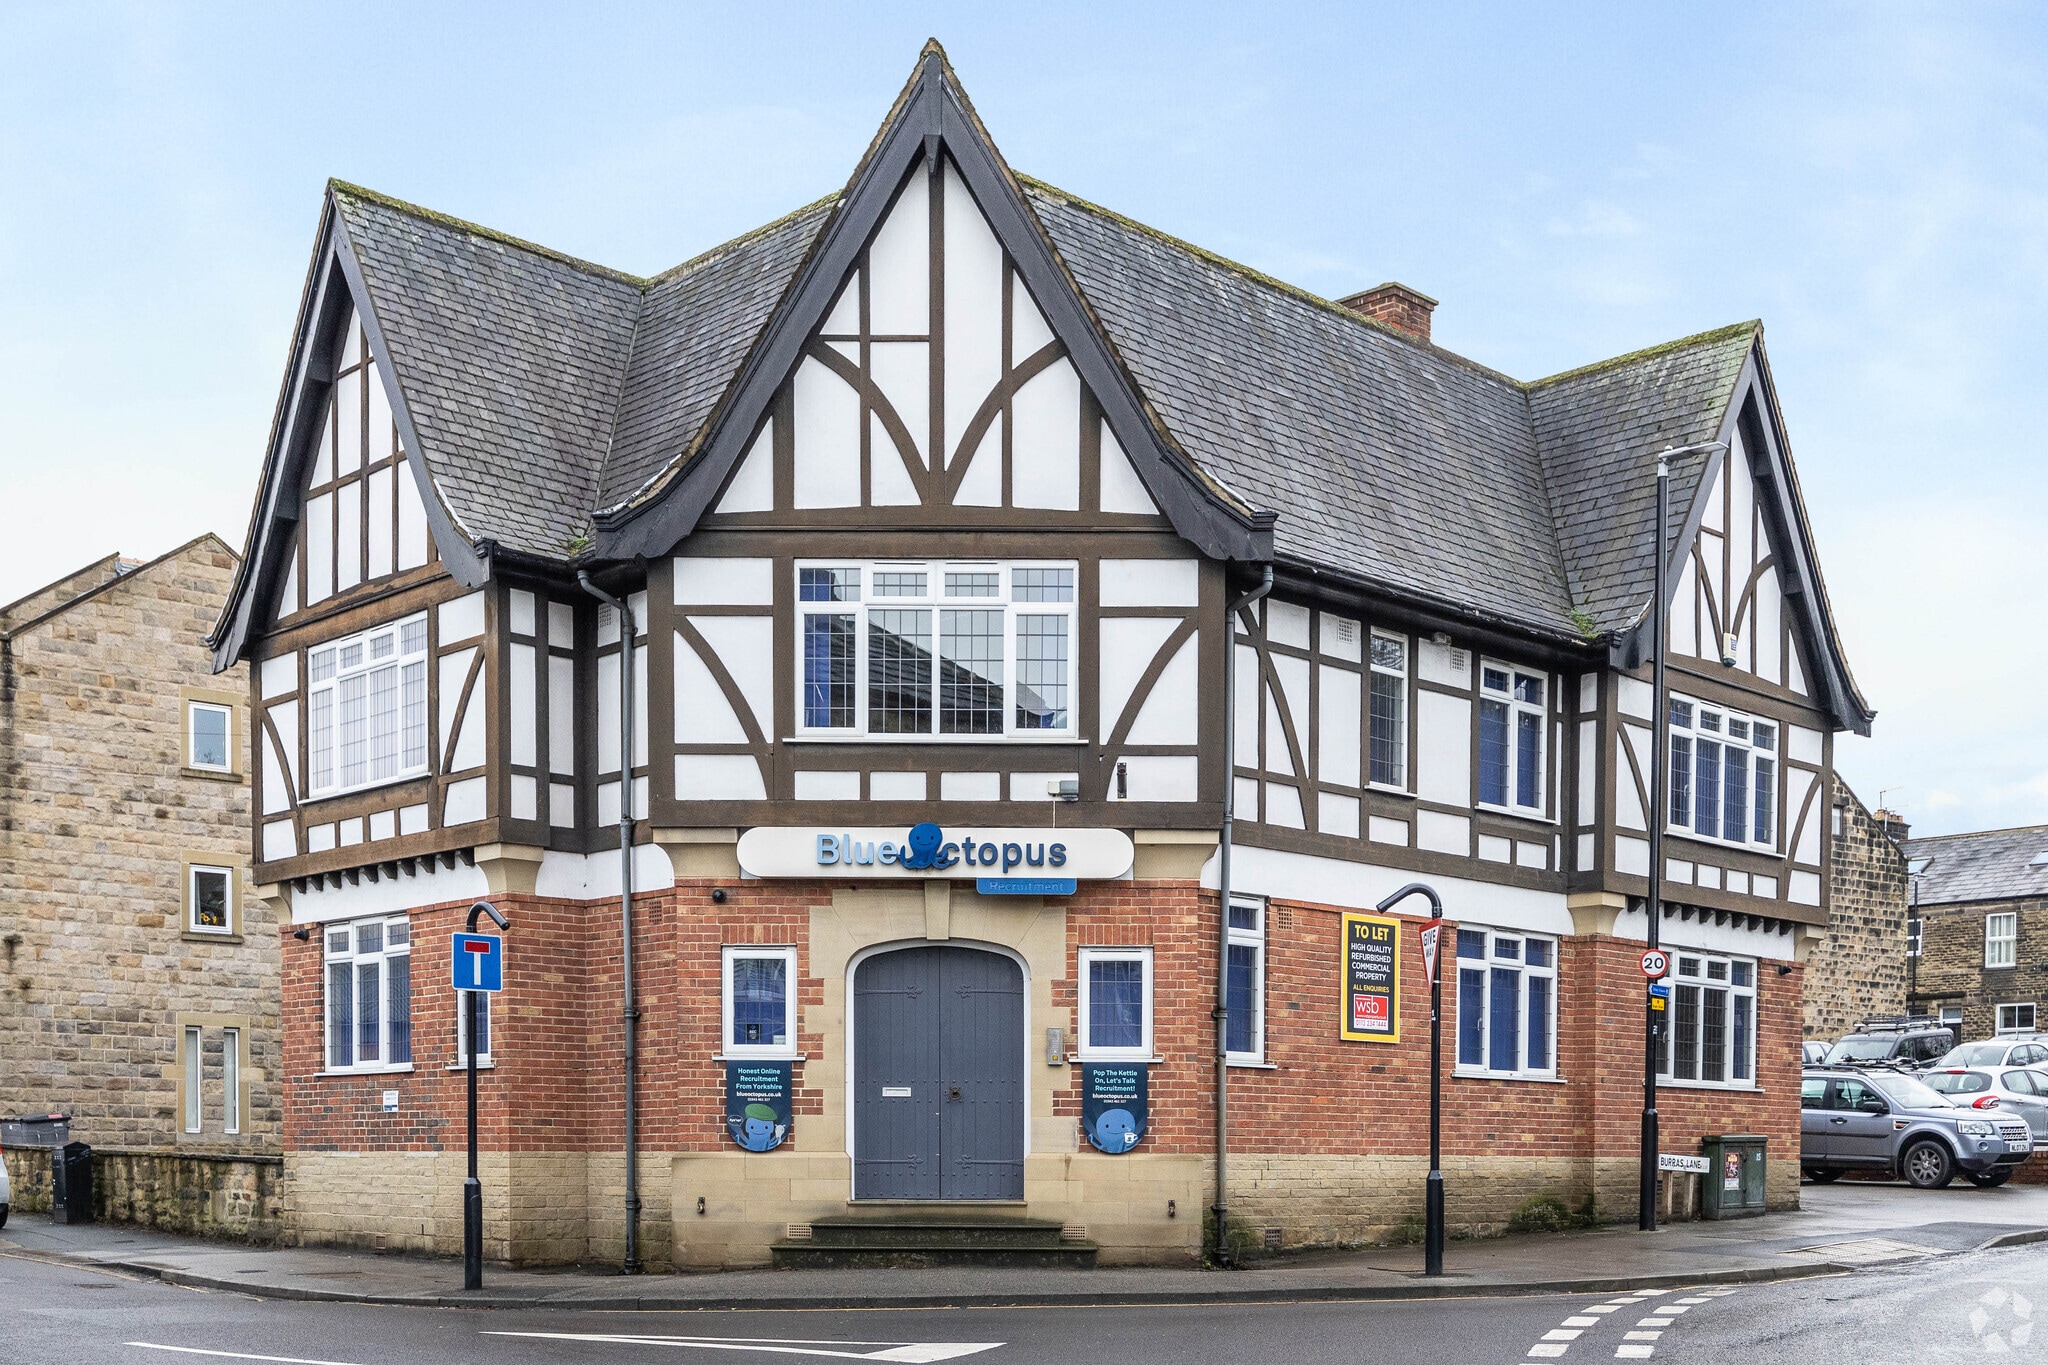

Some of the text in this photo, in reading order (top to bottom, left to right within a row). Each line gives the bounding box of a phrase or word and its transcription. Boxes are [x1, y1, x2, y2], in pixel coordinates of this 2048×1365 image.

[817, 834, 898, 865] Blue
[989, 881, 1063, 891] Recruitment
[1355, 924, 1389, 941] TO LET
[1423, 929, 1436, 946] GIVE
[1351, 943, 1392, 953] HIGH QUALITY
[1426, 947, 1434, 958] WAY
[1351, 952, 1391, 963] REFURBISHED
[1644, 957, 1664, 969] 20
[1351, 961, 1390, 973] COMMERCIAL
[1355, 971, 1387, 981] PROPERTY
[1364, 985, 1389, 993] ENQUIRIES
[1660, 1156, 1701, 1169] BURRAS LANE
